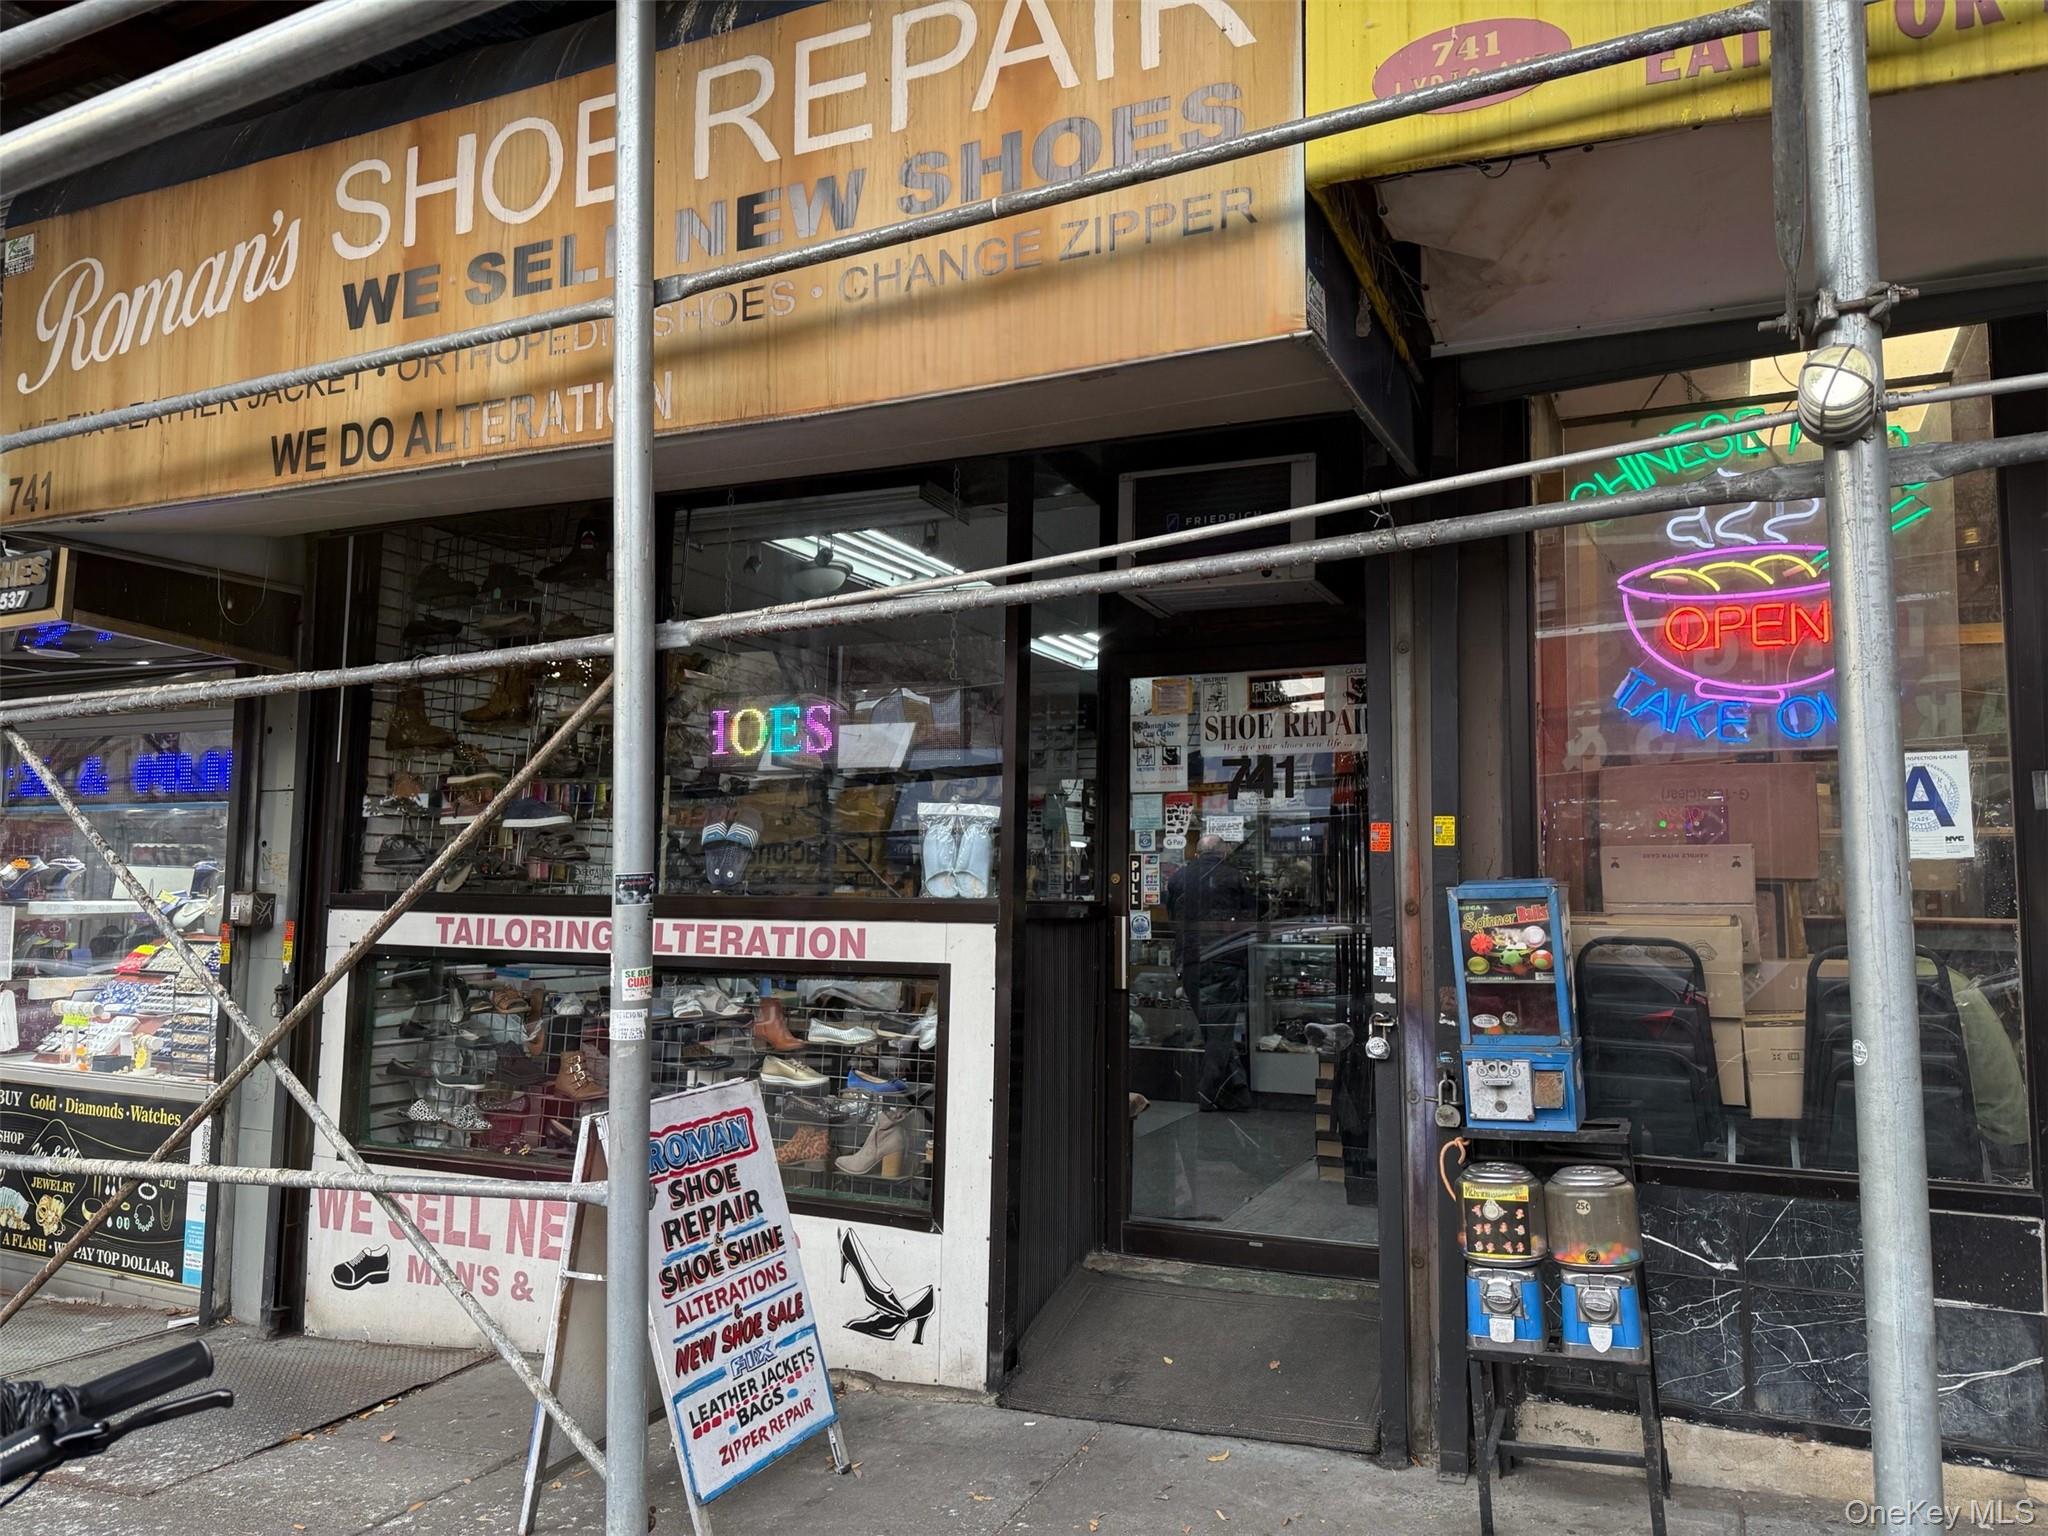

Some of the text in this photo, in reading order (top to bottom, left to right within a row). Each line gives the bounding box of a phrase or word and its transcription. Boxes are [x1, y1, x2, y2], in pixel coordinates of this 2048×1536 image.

[1432, 31, 1501, 67] 741
[343, 265, 441, 330] WE
[676, 170, 867, 263] NEW
[897, 82, 1247, 214] SHOES
[17, 209, 301, 394] Roman's
[332, 94, 616, 260] SHOE
[398, 318, 615, 381] ORTHOPEDI
[654, 280, 796, 337] SHOES
[838, 228, 1043, 304] CHANGE
[1059, 185, 1260, 262] ZIPPER
[271, 427, 327, 477] WE
[340, 417, 394, 467] DO
[9, 471, 52, 515] 741
[1664, 600, 1830, 651] OPEN
[1205, 713, 1273, 741] SHOE
[1615, 668, 1751, 743] TAKE
[1222, 754, 1294, 800] 741
[1906, 766, 1955, 827] A
[1131, 860, 1140, 905] PULL
[436, 917, 866, 960] TAILORING LTERATION
[30, 1093, 56, 1111] Gold
[65, 1098, 124, 1119] Diamonds
[131, 1105, 181, 1126] Watches
[650, 1116, 750, 1176] ROMAN
[31, 1177, 76, 1193] JEWELRY
[668, 1163, 741, 1211] SHOE
[318, 1189, 373, 1235] WE
[506, 1197, 566, 1261] NE
[662, 1188, 764, 1252] REPAIR
[714, 1232, 724, 1247] &
[3, 1232, 12, 1245] A
[13, 1233, 47, 1252] FLASH
[73, 1247, 94, 1262] PAY
[97, 1250, 118, 1266] TOP
[660, 1224, 787, 1300] SHOE SHINE
[408, 1255, 535, 1302] MN'S &
[675, 1261, 788, 1329] ALTERATIONS
[675, 1292, 805, 1378] NEW SHOE SALE
[734, 1304, 744, 1320] &
[730, 1340, 778, 1380] FIX
[689, 1346, 816, 1429] LEATHER JACKETS
[737, 1387, 785, 1429] BAGS
[718, 1398, 815, 1467] ZIPPER REPAIR
